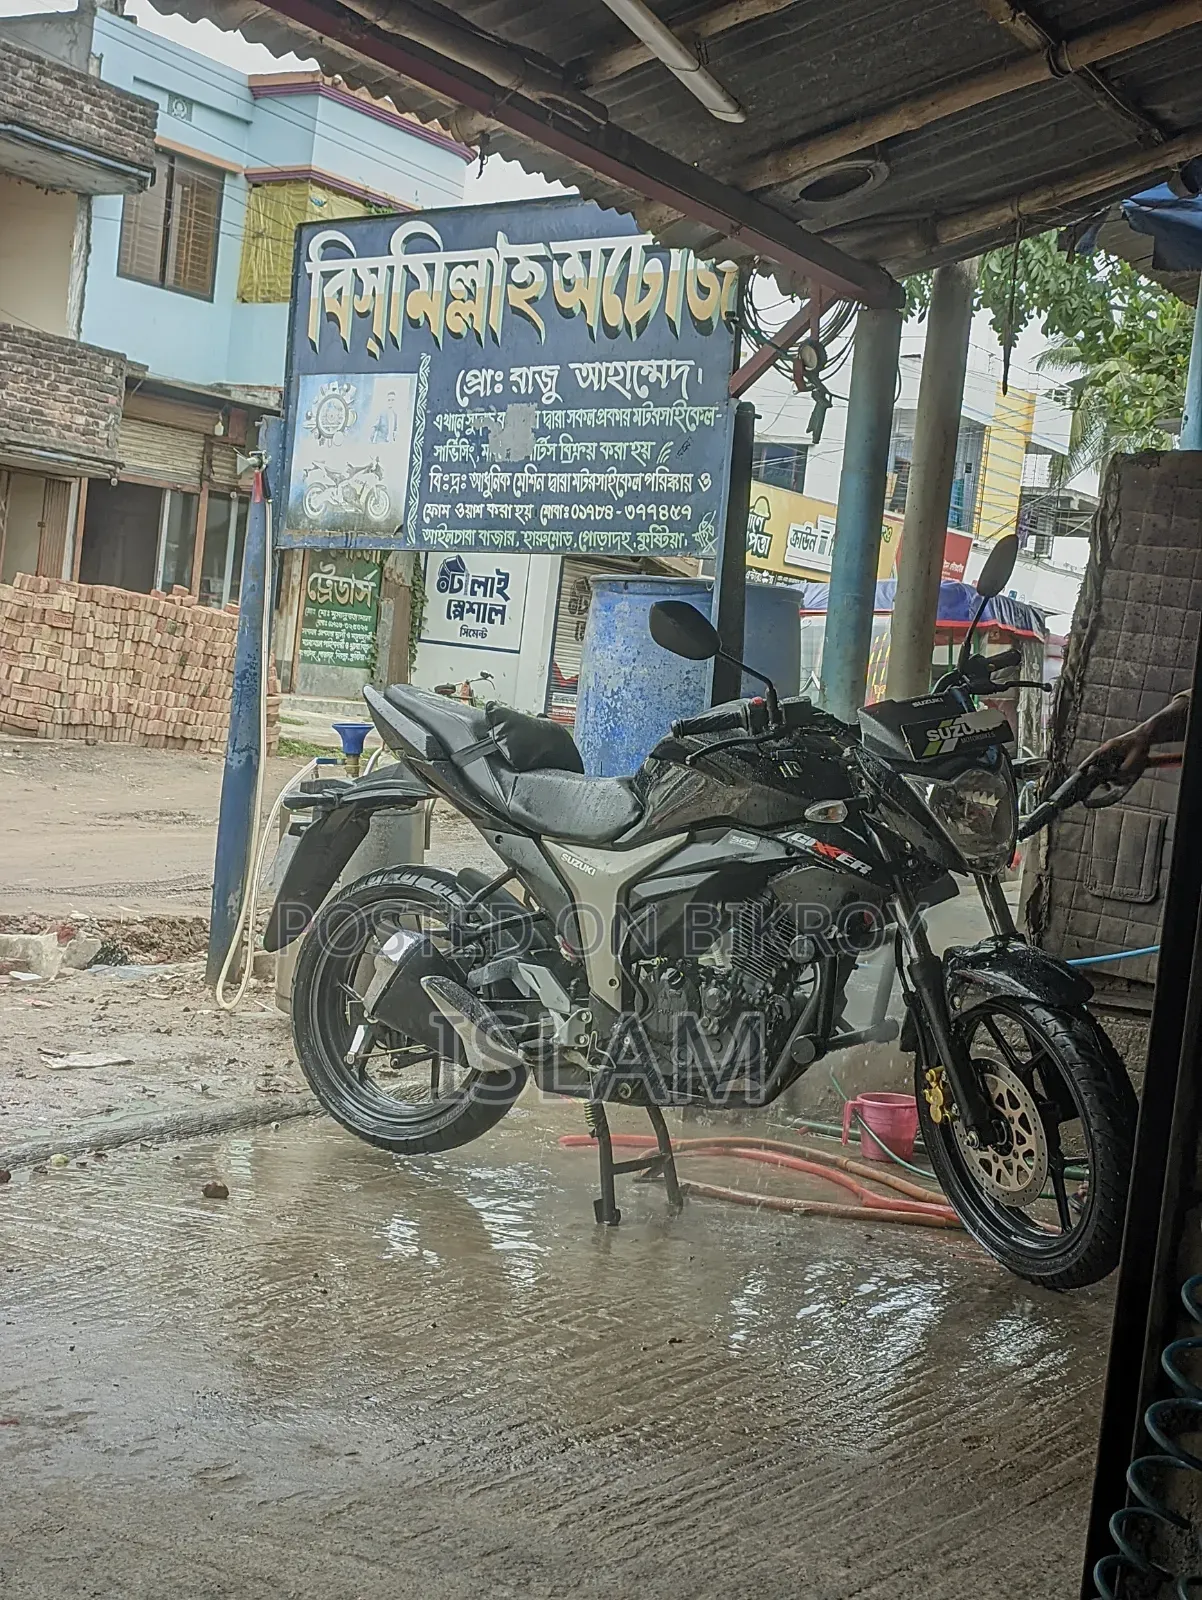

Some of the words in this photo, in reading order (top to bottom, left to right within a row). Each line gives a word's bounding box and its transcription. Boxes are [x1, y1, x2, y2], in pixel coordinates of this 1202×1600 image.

[509, 364, 563, 404] রাজু
[433, 413, 466, 437] এখানে
[566, 408, 597, 428] সকল
[596, 407, 632, 428] প্রকার
[600, 441, 629, 461] করা
[629, 441, 656, 467] হয়
[469, 462, 512, 499] আধুনিক
[513, 463, 546, 498] মেশিন
[572, 468, 644, 500] মটরসাইকেল
[698, 472, 712, 493] ও
[422, 502, 451, 524] ফোম
[454, 502, 485, 519] ওয়াশ
[486, 503, 513, 519] করা
[513, 504, 534, 525] হয়
[446, 599, 507, 626] স্পেশাল
[459, 625, 489, 640] সিমেন্ট
[912, 697, 944, 708] SUZUKI
[560, 853, 596, 877] SUZUKI
